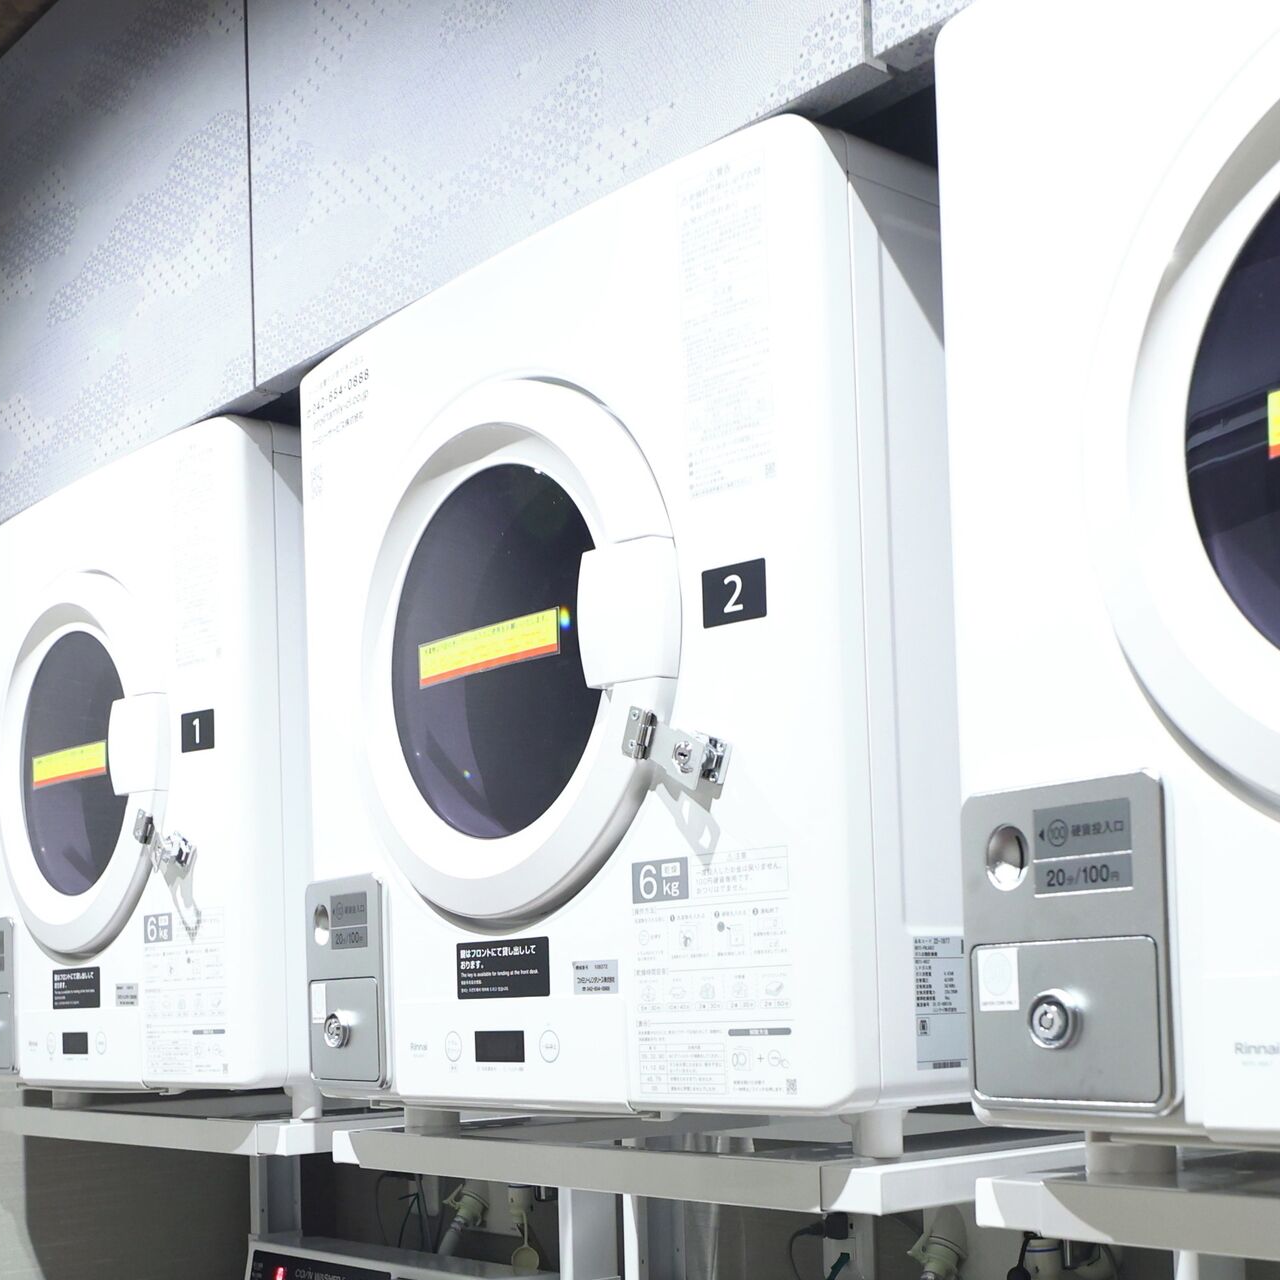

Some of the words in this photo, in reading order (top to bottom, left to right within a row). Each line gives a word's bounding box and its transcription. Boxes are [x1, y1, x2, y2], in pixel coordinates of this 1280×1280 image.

[722, 574, 745, 614] 2
[193, 717, 201, 745] 1
[1071, 819, 1124, 838] 硬貨投入口
[639, 864, 658, 900] 6
[662, 879, 679, 897] kg
[147, 916, 158, 942] 6
[158, 927, 169, 941] kg
[459, 944, 537, 960] 鍵はフロントにて貸し出しして
[460, 960, 484, 970] おります。
[1234, 1042, 1280, 1056] Rinnai
